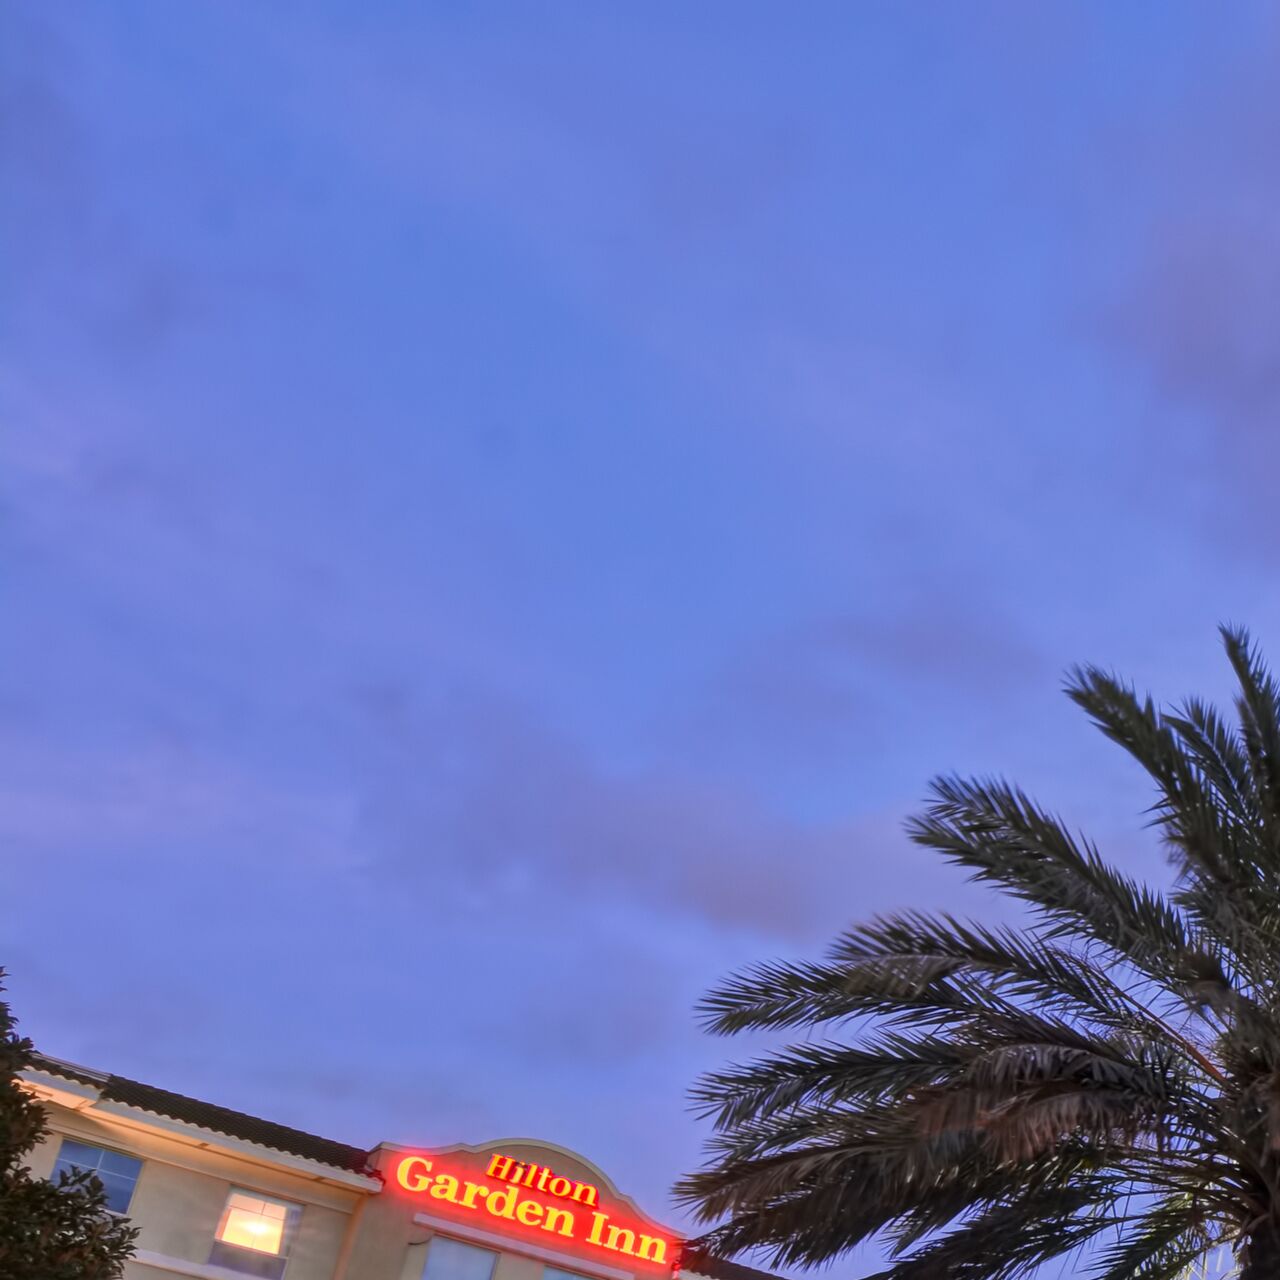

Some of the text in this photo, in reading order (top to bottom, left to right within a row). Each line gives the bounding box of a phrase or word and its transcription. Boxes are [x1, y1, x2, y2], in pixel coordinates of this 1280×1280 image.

[397, 1156, 668, 1264] Garden Inn
[486, 1154, 598, 1207] Hilton
